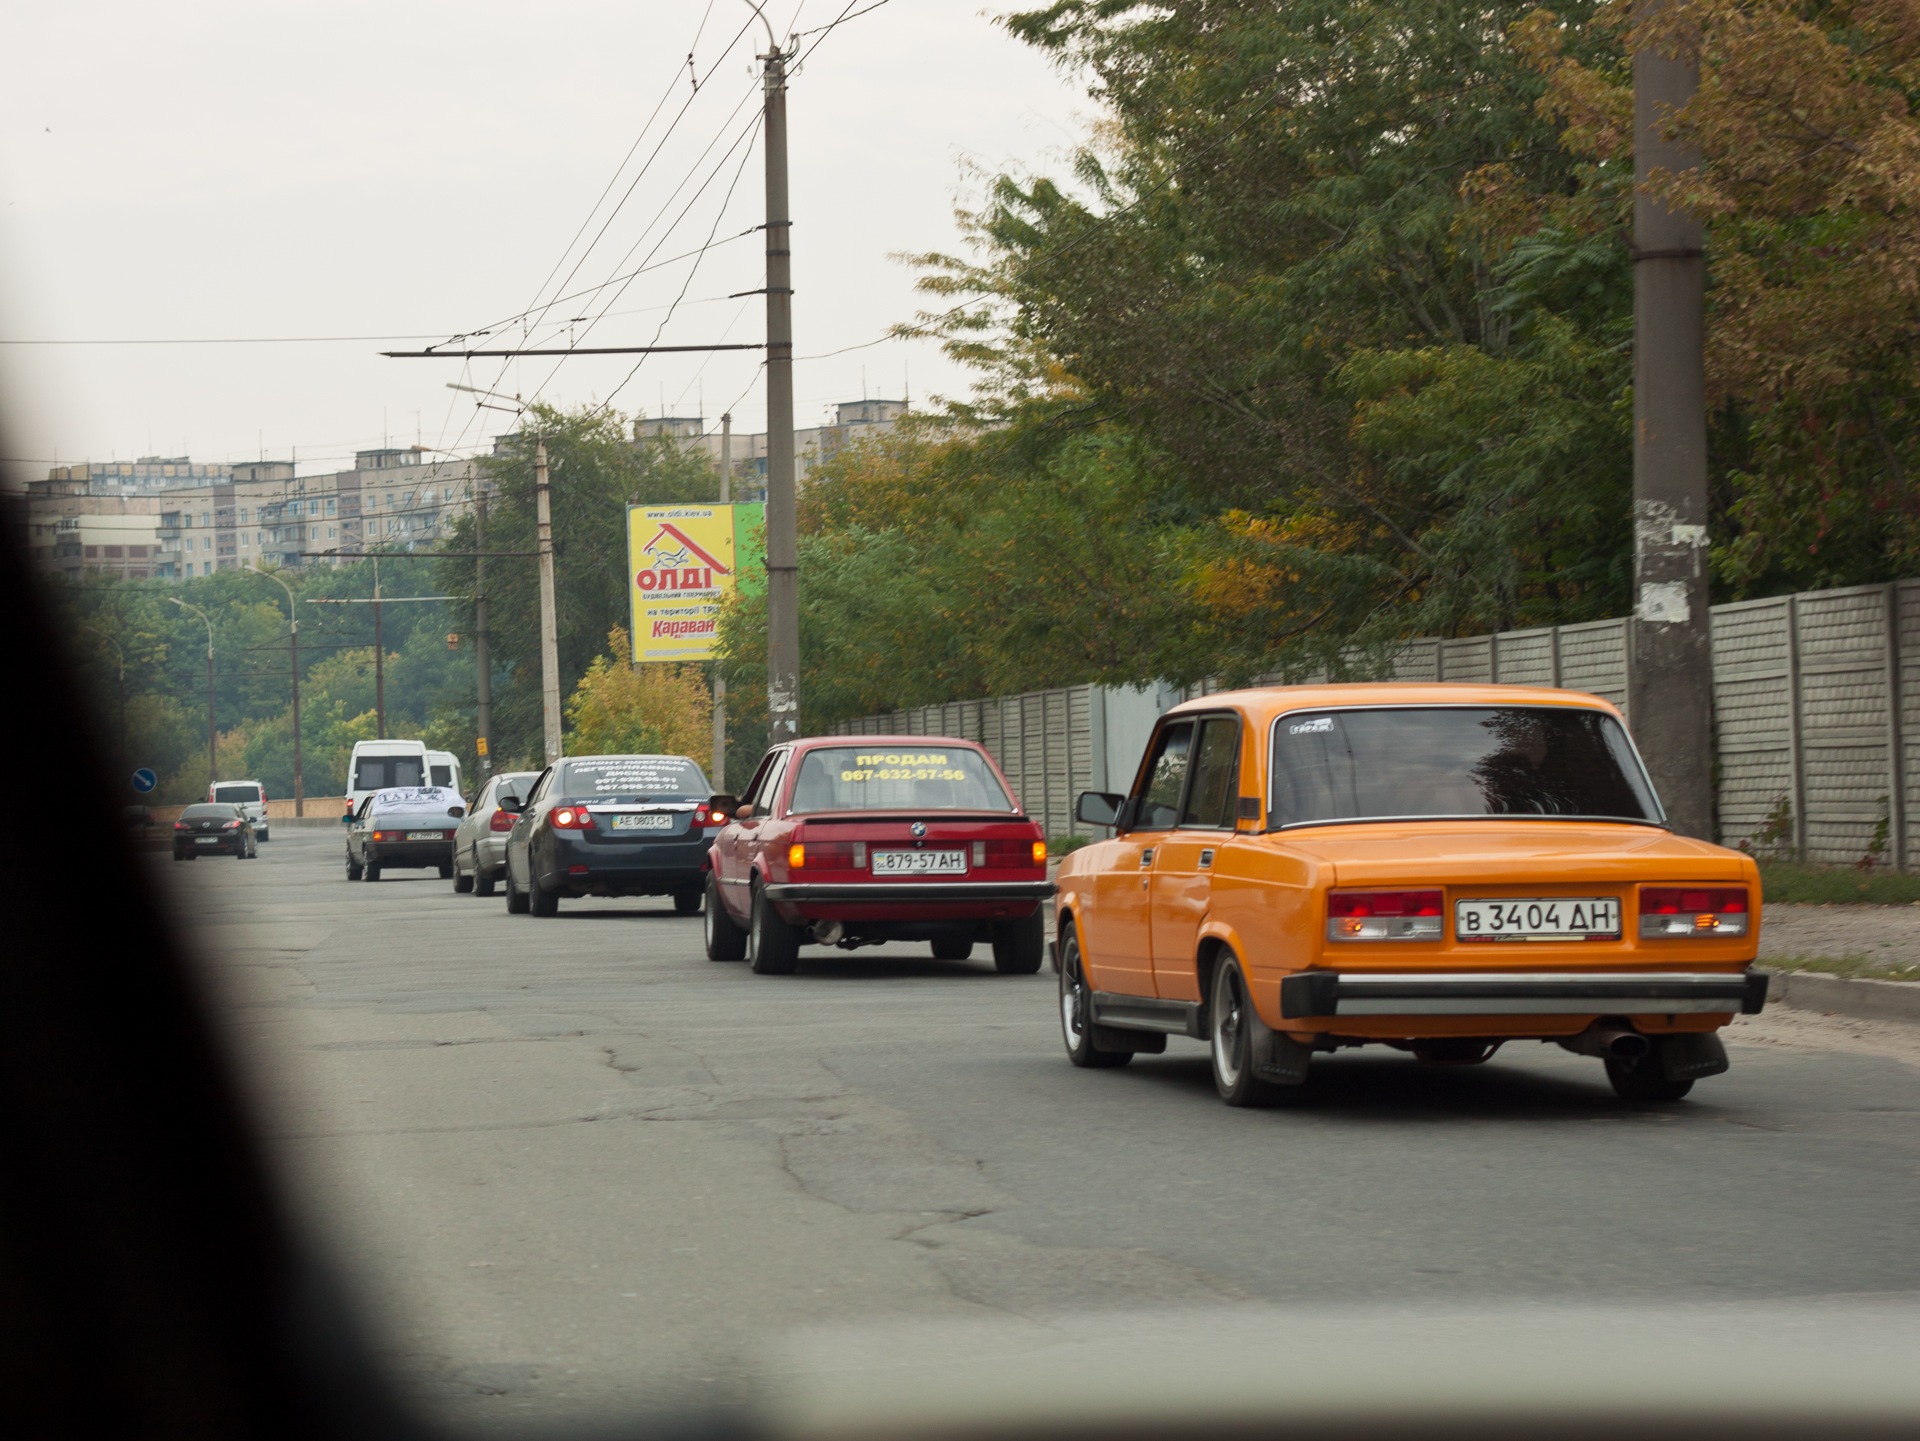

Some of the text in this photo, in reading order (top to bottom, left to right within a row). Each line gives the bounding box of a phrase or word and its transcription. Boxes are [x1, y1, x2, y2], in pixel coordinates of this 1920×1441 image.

[637, 568, 713, 590] ОЛДІ
[652, 620, 716, 638] Караван
[856, 754, 948, 766] ПРОДАМ
[886, 854, 936, 869] 879-57
[1488, 904, 1561, 930] 3404
[1569, 903, 1609, 930] ДН
